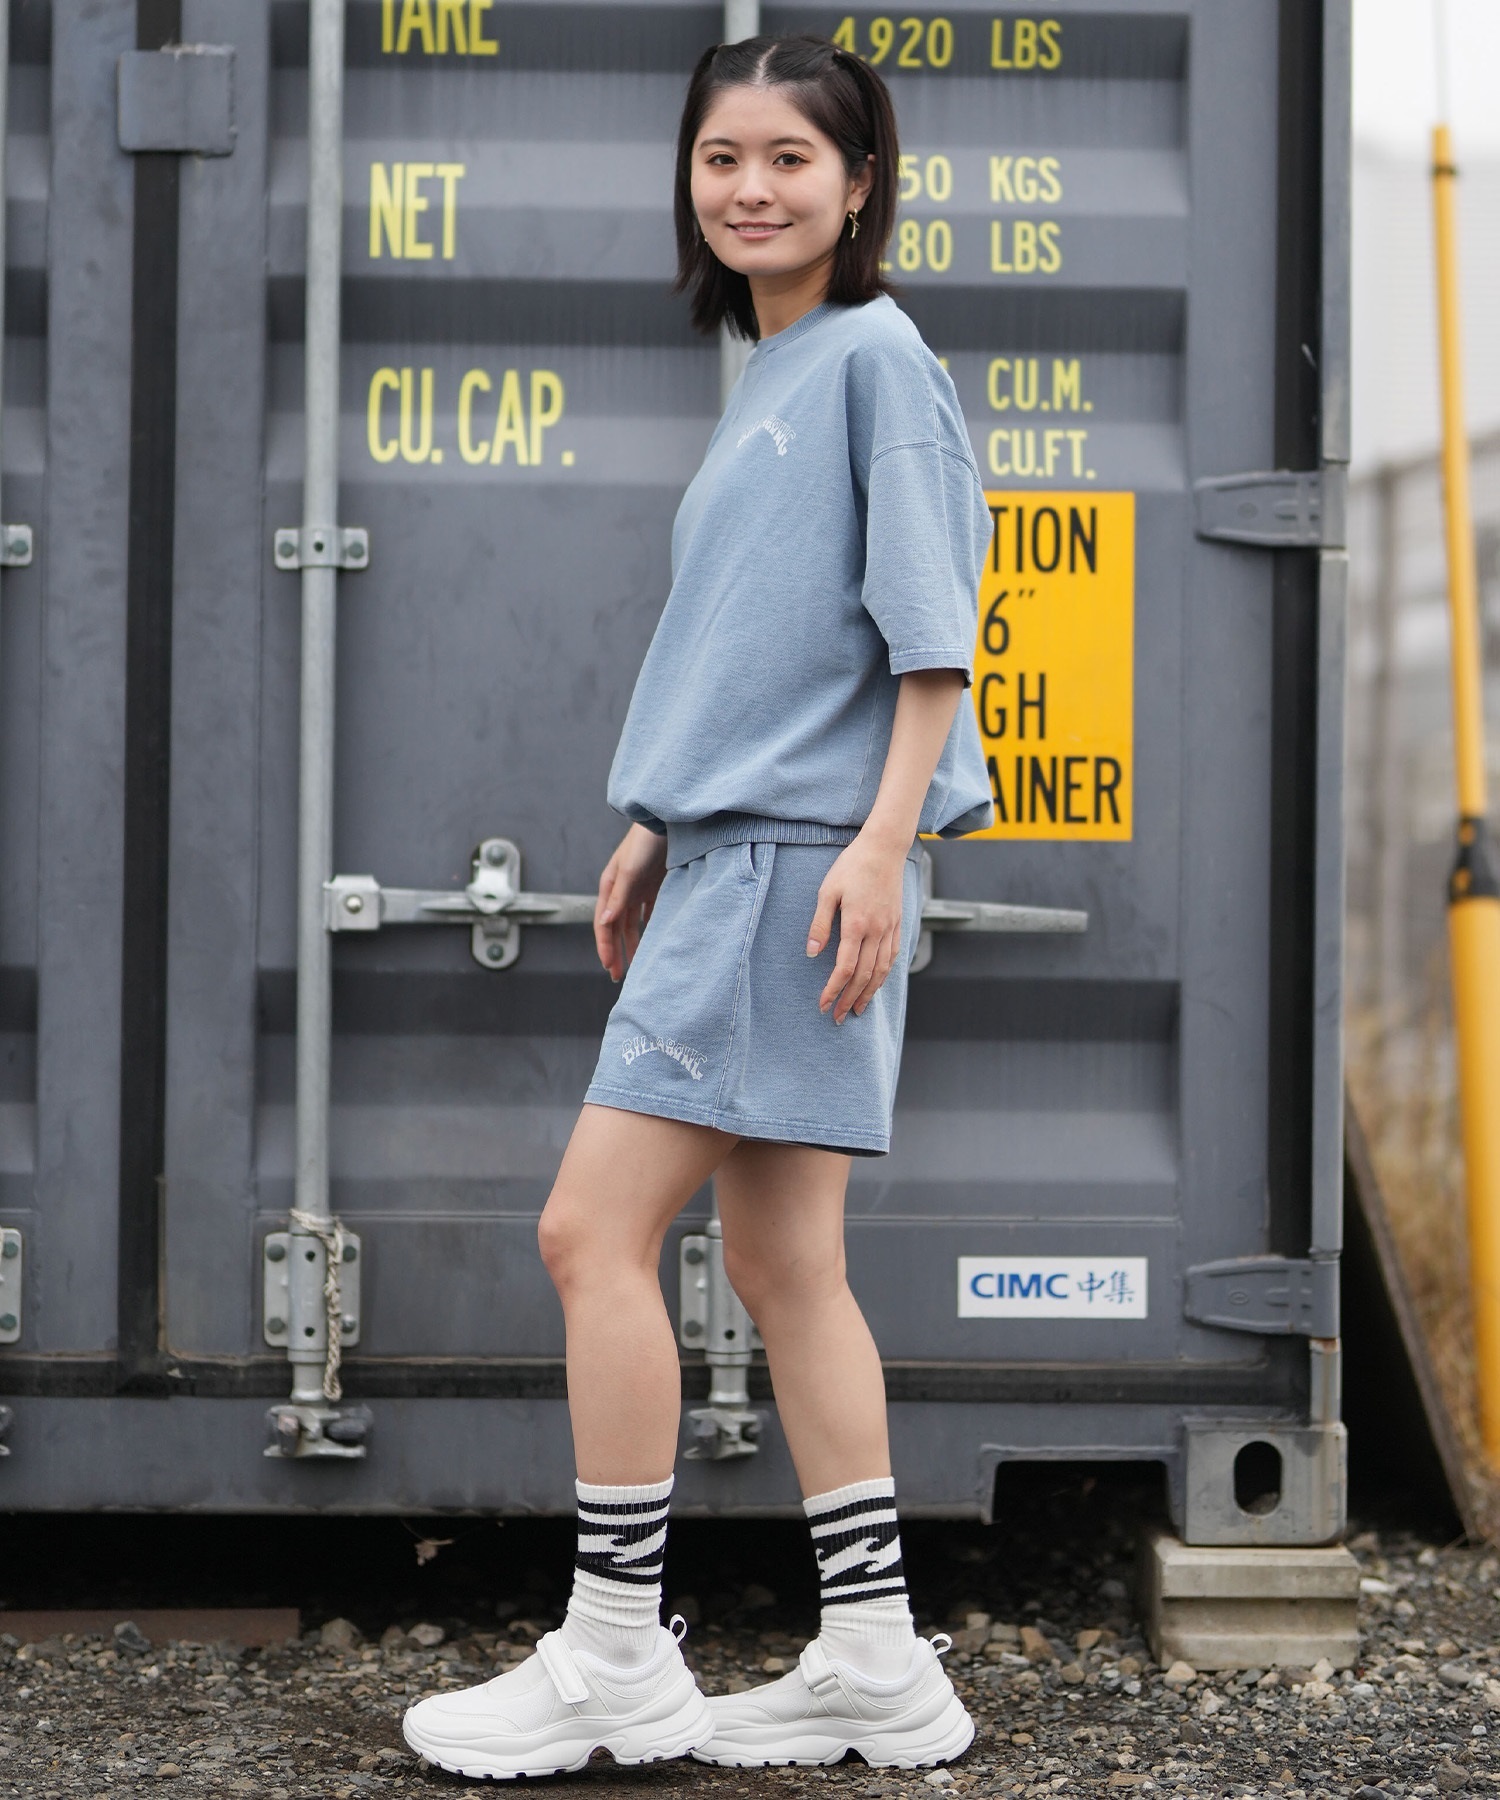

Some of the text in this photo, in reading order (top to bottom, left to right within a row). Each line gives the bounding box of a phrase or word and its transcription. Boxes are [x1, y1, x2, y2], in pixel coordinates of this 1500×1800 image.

[990, 18, 1063, 69] LBS
[989, 155, 1063, 203] KGS
[369, 162, 466, 260] NET
[879, 219, 1063, 273] 80 LBS
[970, 1270, 1135, 1304] CIMC 中集
